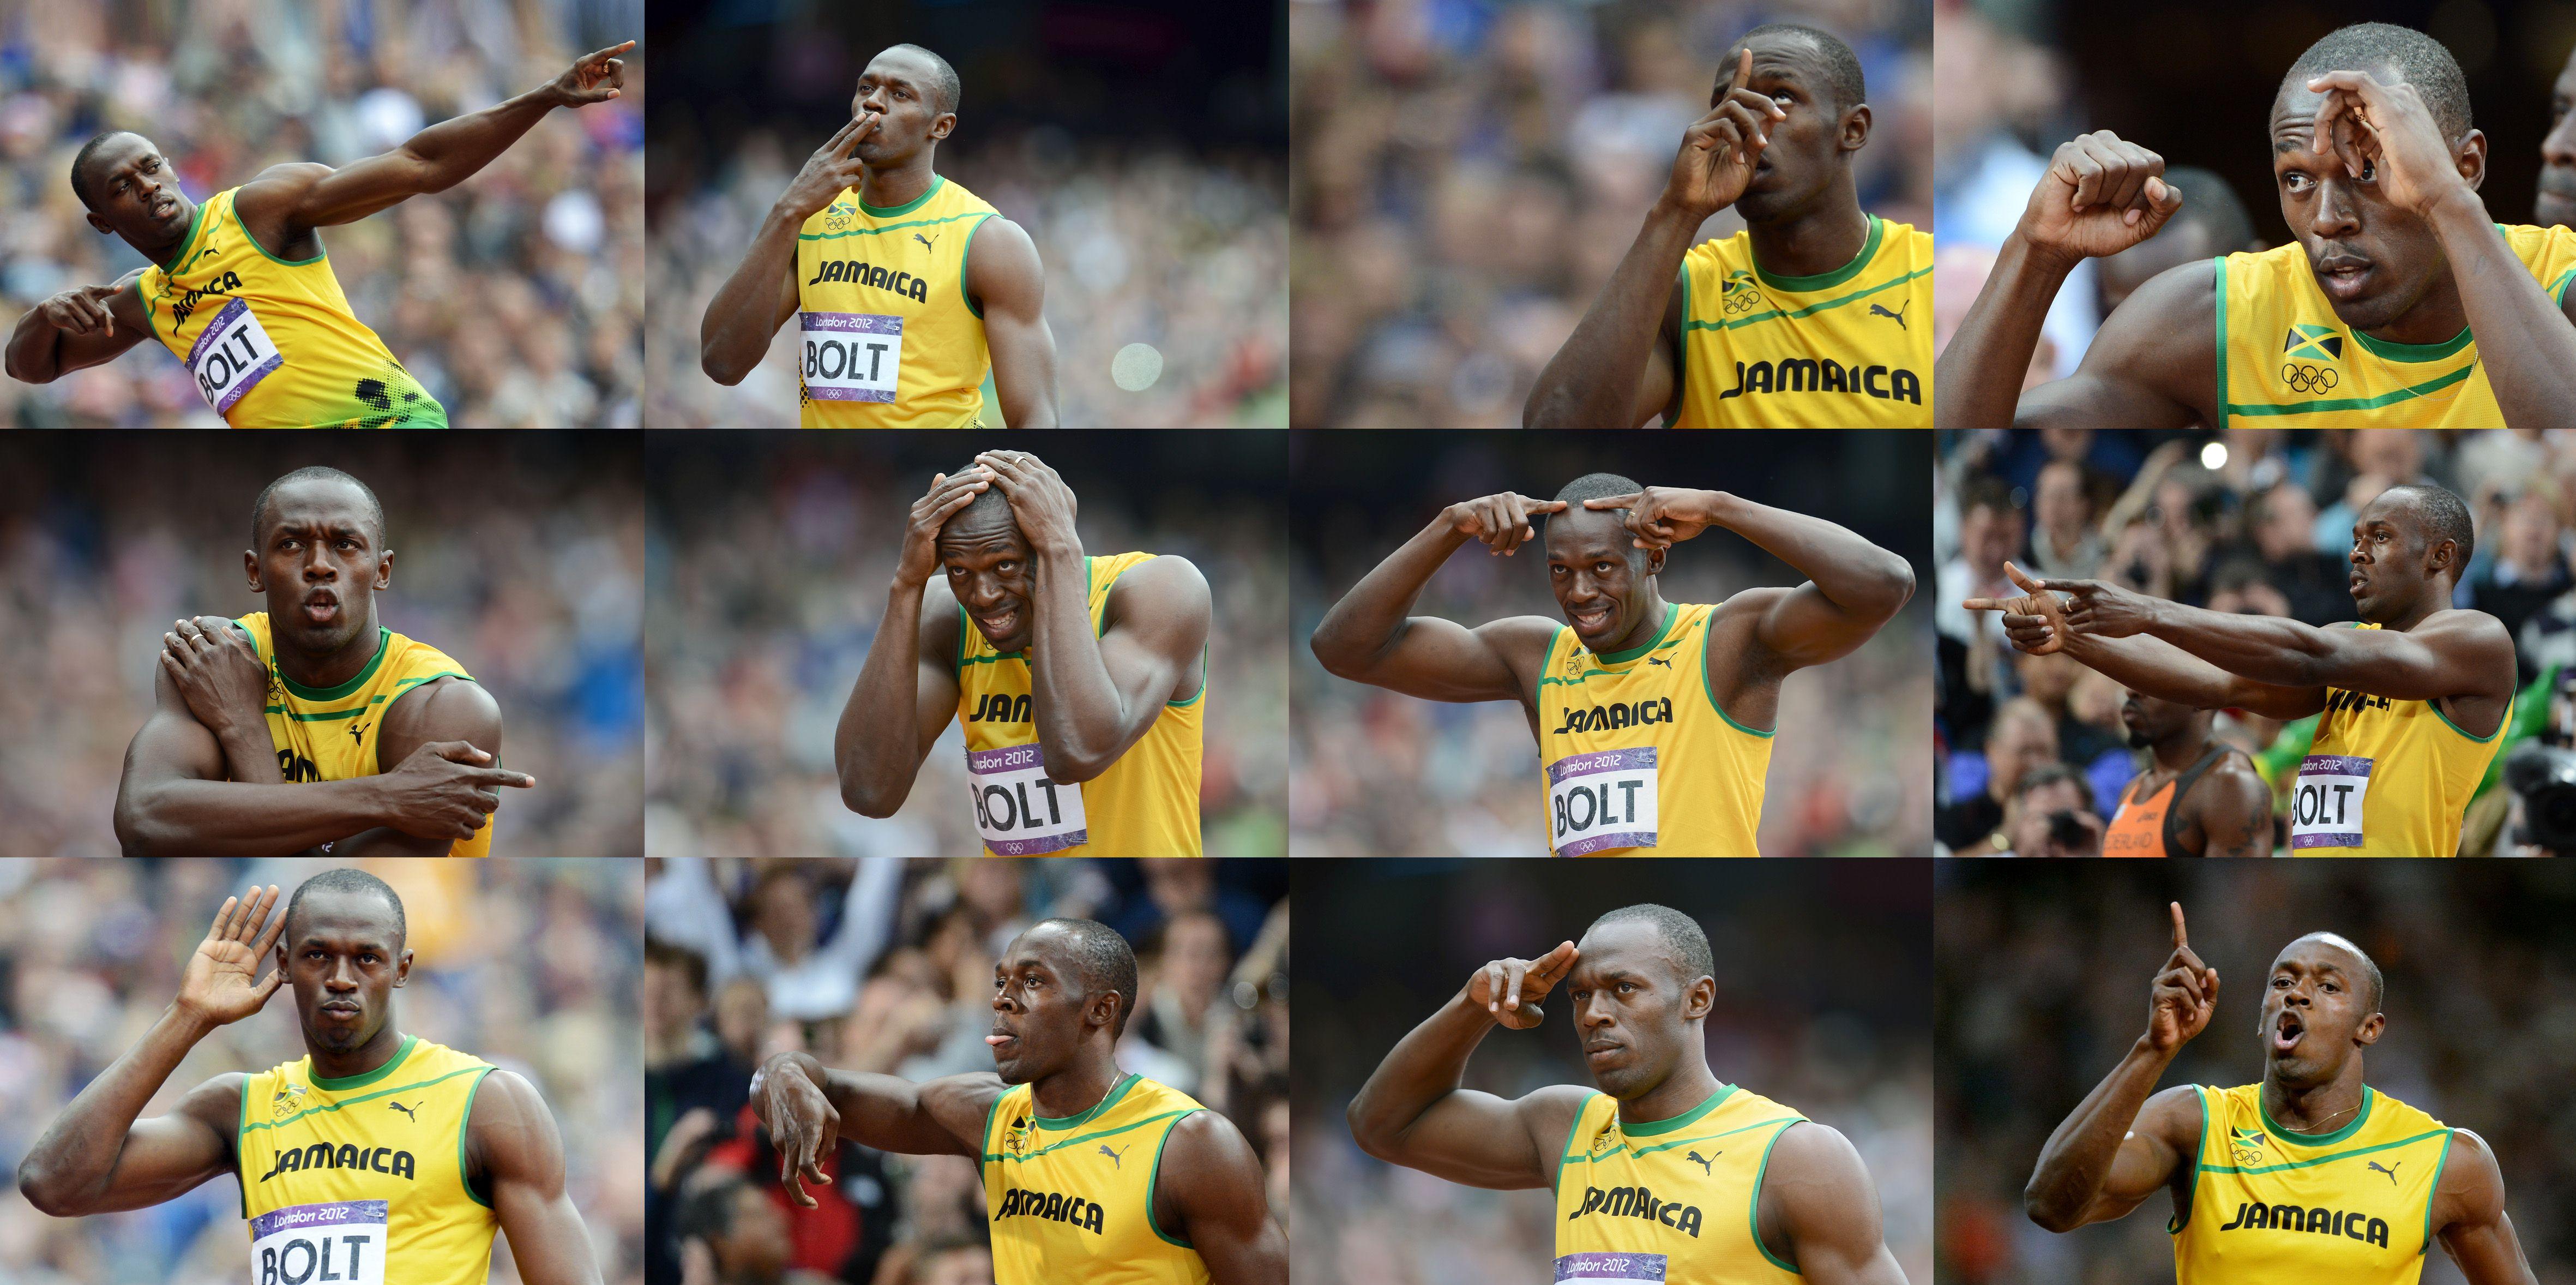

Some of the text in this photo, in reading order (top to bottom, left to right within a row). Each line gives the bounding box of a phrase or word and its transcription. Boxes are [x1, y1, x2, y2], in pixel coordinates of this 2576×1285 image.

[809, 260, 927, 304] JAMAICA
[194, 316, 225, 359] London 2012
[815, 316, 873, 329] London 2012
[199, 324, 258, 406] BOLT
[806, 340, 888, 381] BOLT
[1719, 358, 1921, 406] JAMAICA
[1553, 696, 1673, 734] JAMAICA
[1005, 750, 1034, 765] 2012
[1560, 755, 1622, 777] London 2012
[2300, 759, 2342, 771] ndon 2012
[971, 778, 1061, 831] BOLT
[1555, 780, 1643, 838] BOLT
[2292, 784, 2354, 826] BOLT
[260, 1142, 415, 1183] JAMAICA
[274, 1206, 349, 1228] London 2012
[1568, 1186, 1702, 1239] JAMAICA
[2220, 1202, 2388, 1249] JAMAICA
[262, 1235, 370, 1285] BOLT
[1567, 1257, 1630, 1274] London 2012
